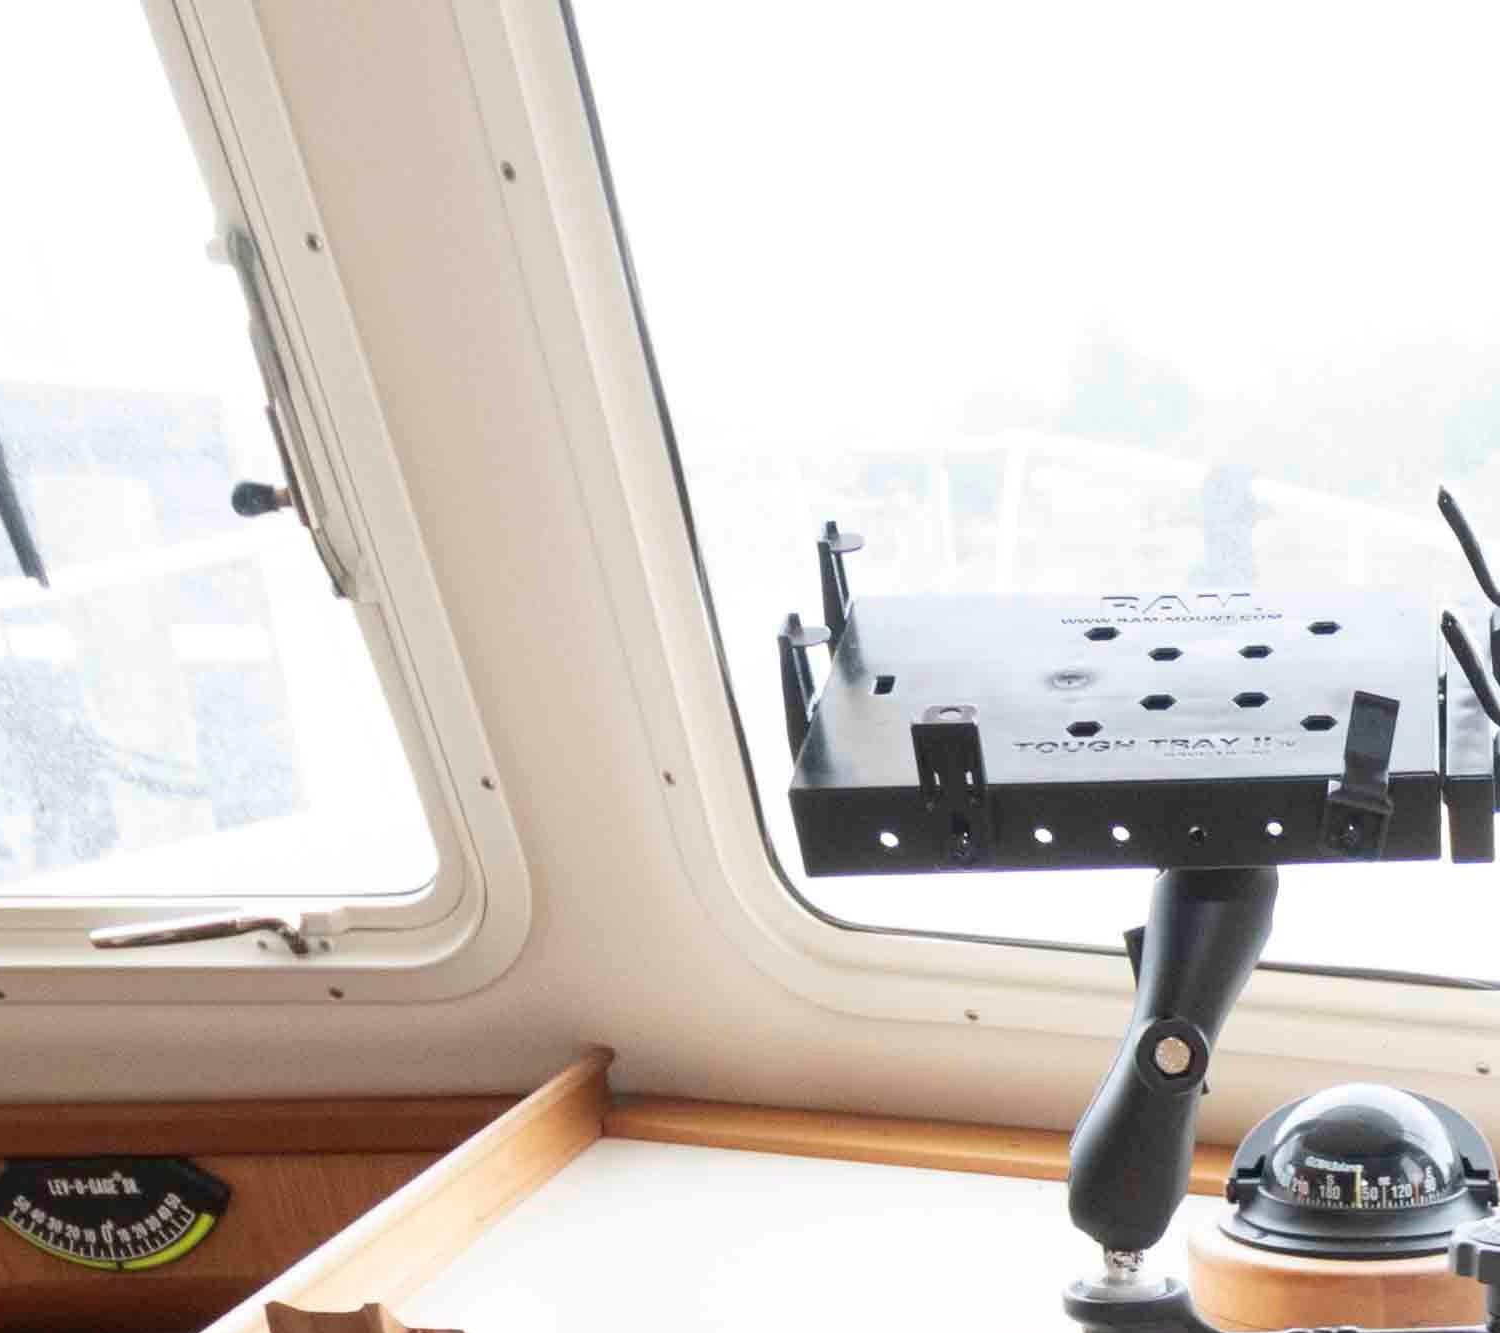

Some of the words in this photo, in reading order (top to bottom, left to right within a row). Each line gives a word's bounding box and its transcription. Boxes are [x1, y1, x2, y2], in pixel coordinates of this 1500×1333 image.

[1013, 738, 1136, 754] TOUGH
[1149, 737, 1242, 751] TRAY
[1391, 1183, 1413, 1199] 120
[65, 1223, 80, 1240] 20
[84, 1228, 96, 1243] 10
[131, 1223, 147, 1239] 20
